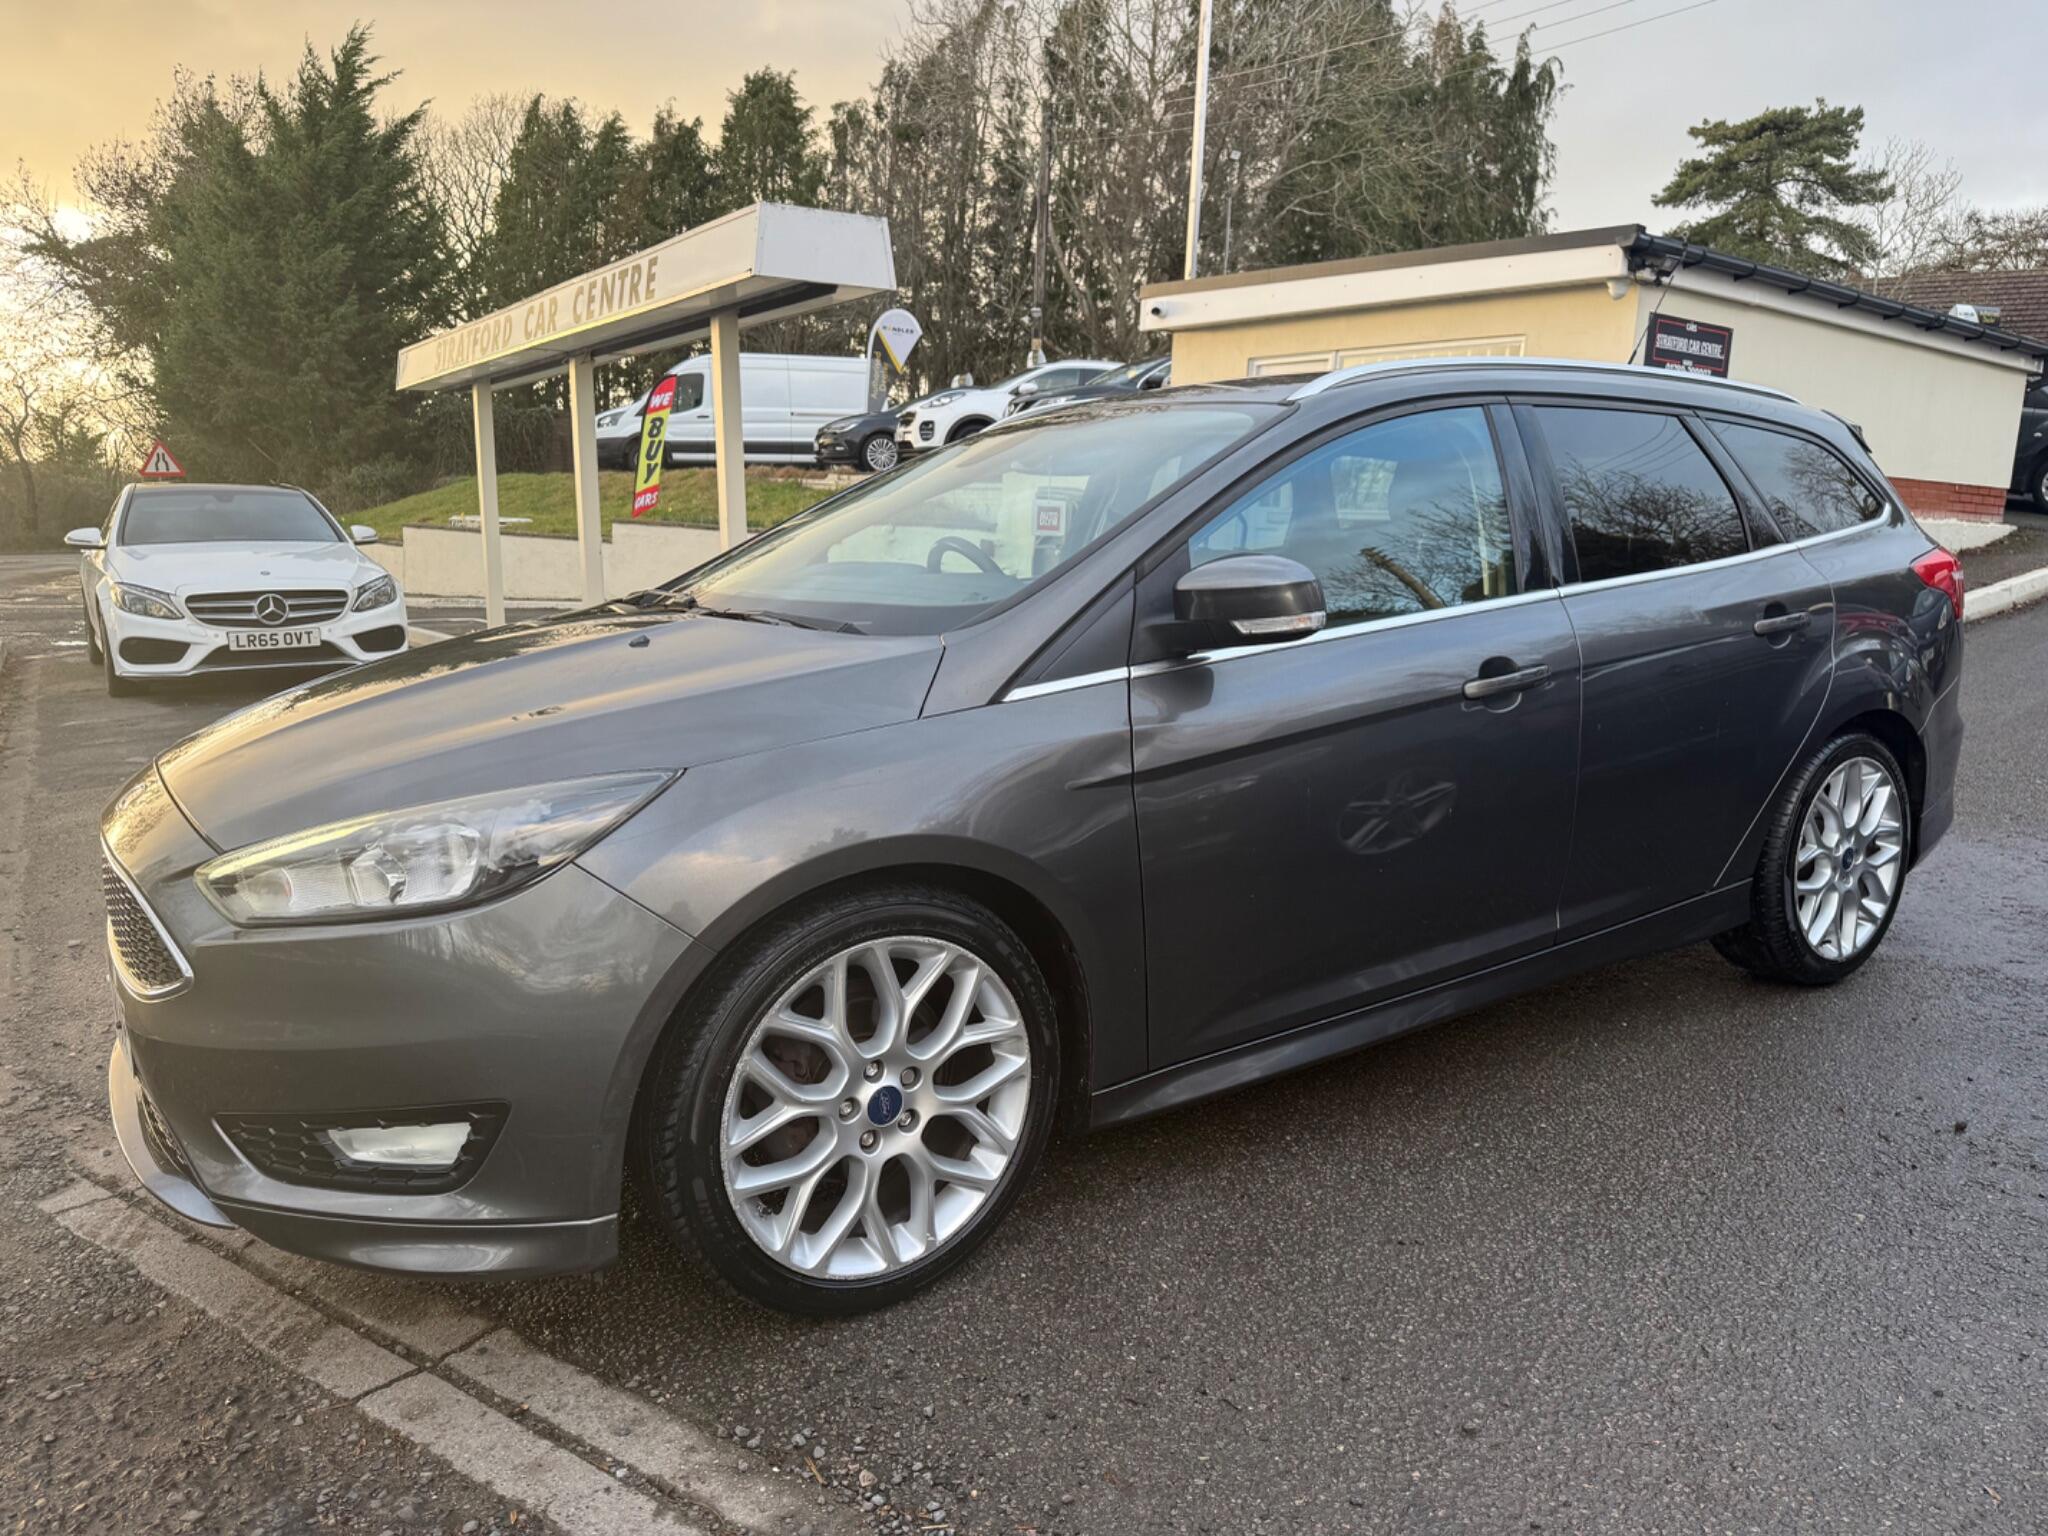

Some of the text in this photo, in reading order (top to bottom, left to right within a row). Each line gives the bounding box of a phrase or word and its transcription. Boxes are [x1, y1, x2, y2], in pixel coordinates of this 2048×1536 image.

[435, 256, 659, 371] STRATFORD CAR CENTRE
[650, 392, 673, 409] WE
[644, 416, 664, 484] BUY
[236, 630, 313, 648] LR65 OVT
